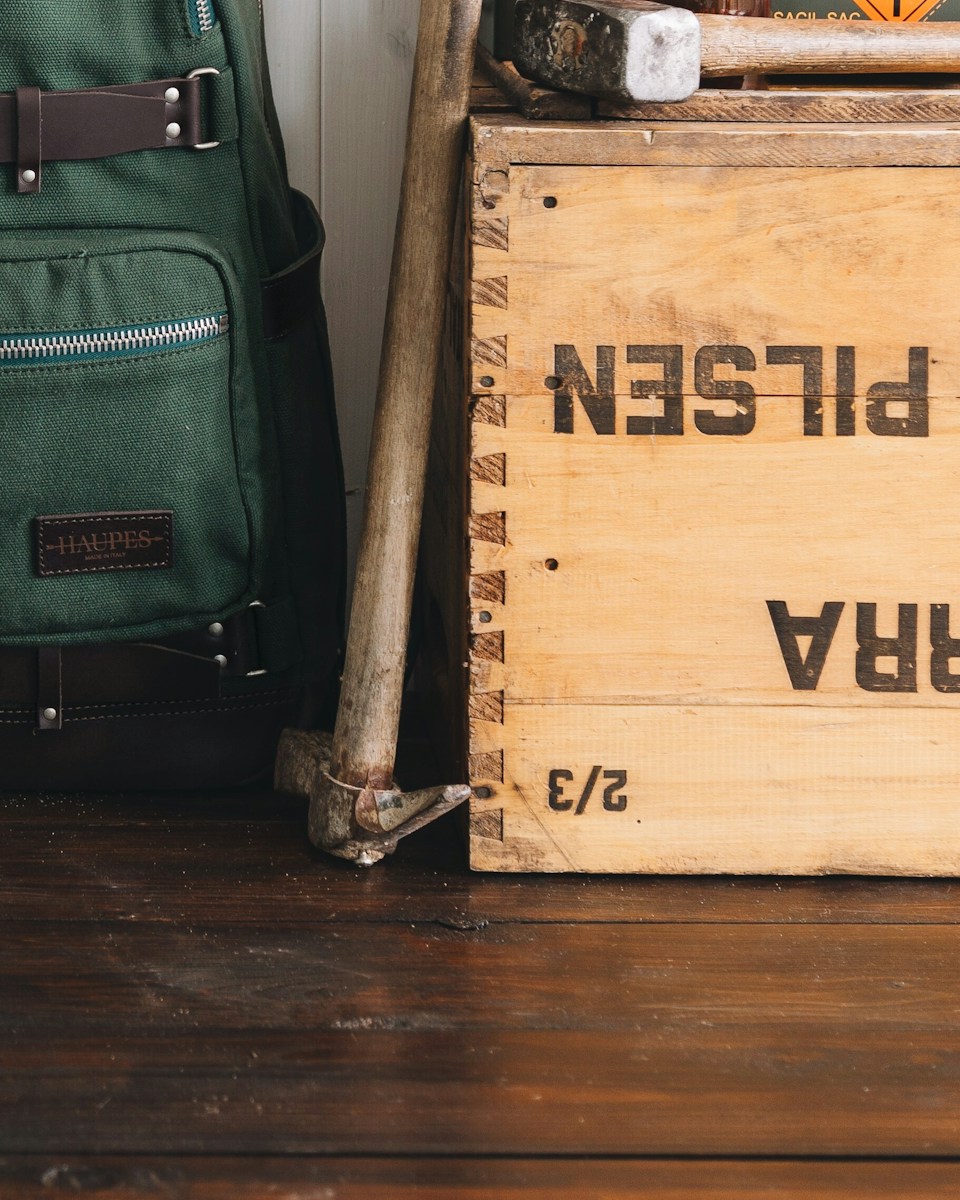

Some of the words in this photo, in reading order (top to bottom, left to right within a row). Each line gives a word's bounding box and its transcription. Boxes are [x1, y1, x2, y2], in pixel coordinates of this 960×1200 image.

[553, 344, 929, 437] PILSEN
[58, 529, 153, 555] HAUPES
[85, 553, 102, 561] MADE
[110, 551, 127, 559] ITALY
[548, 765, 628, 816] 2/3
